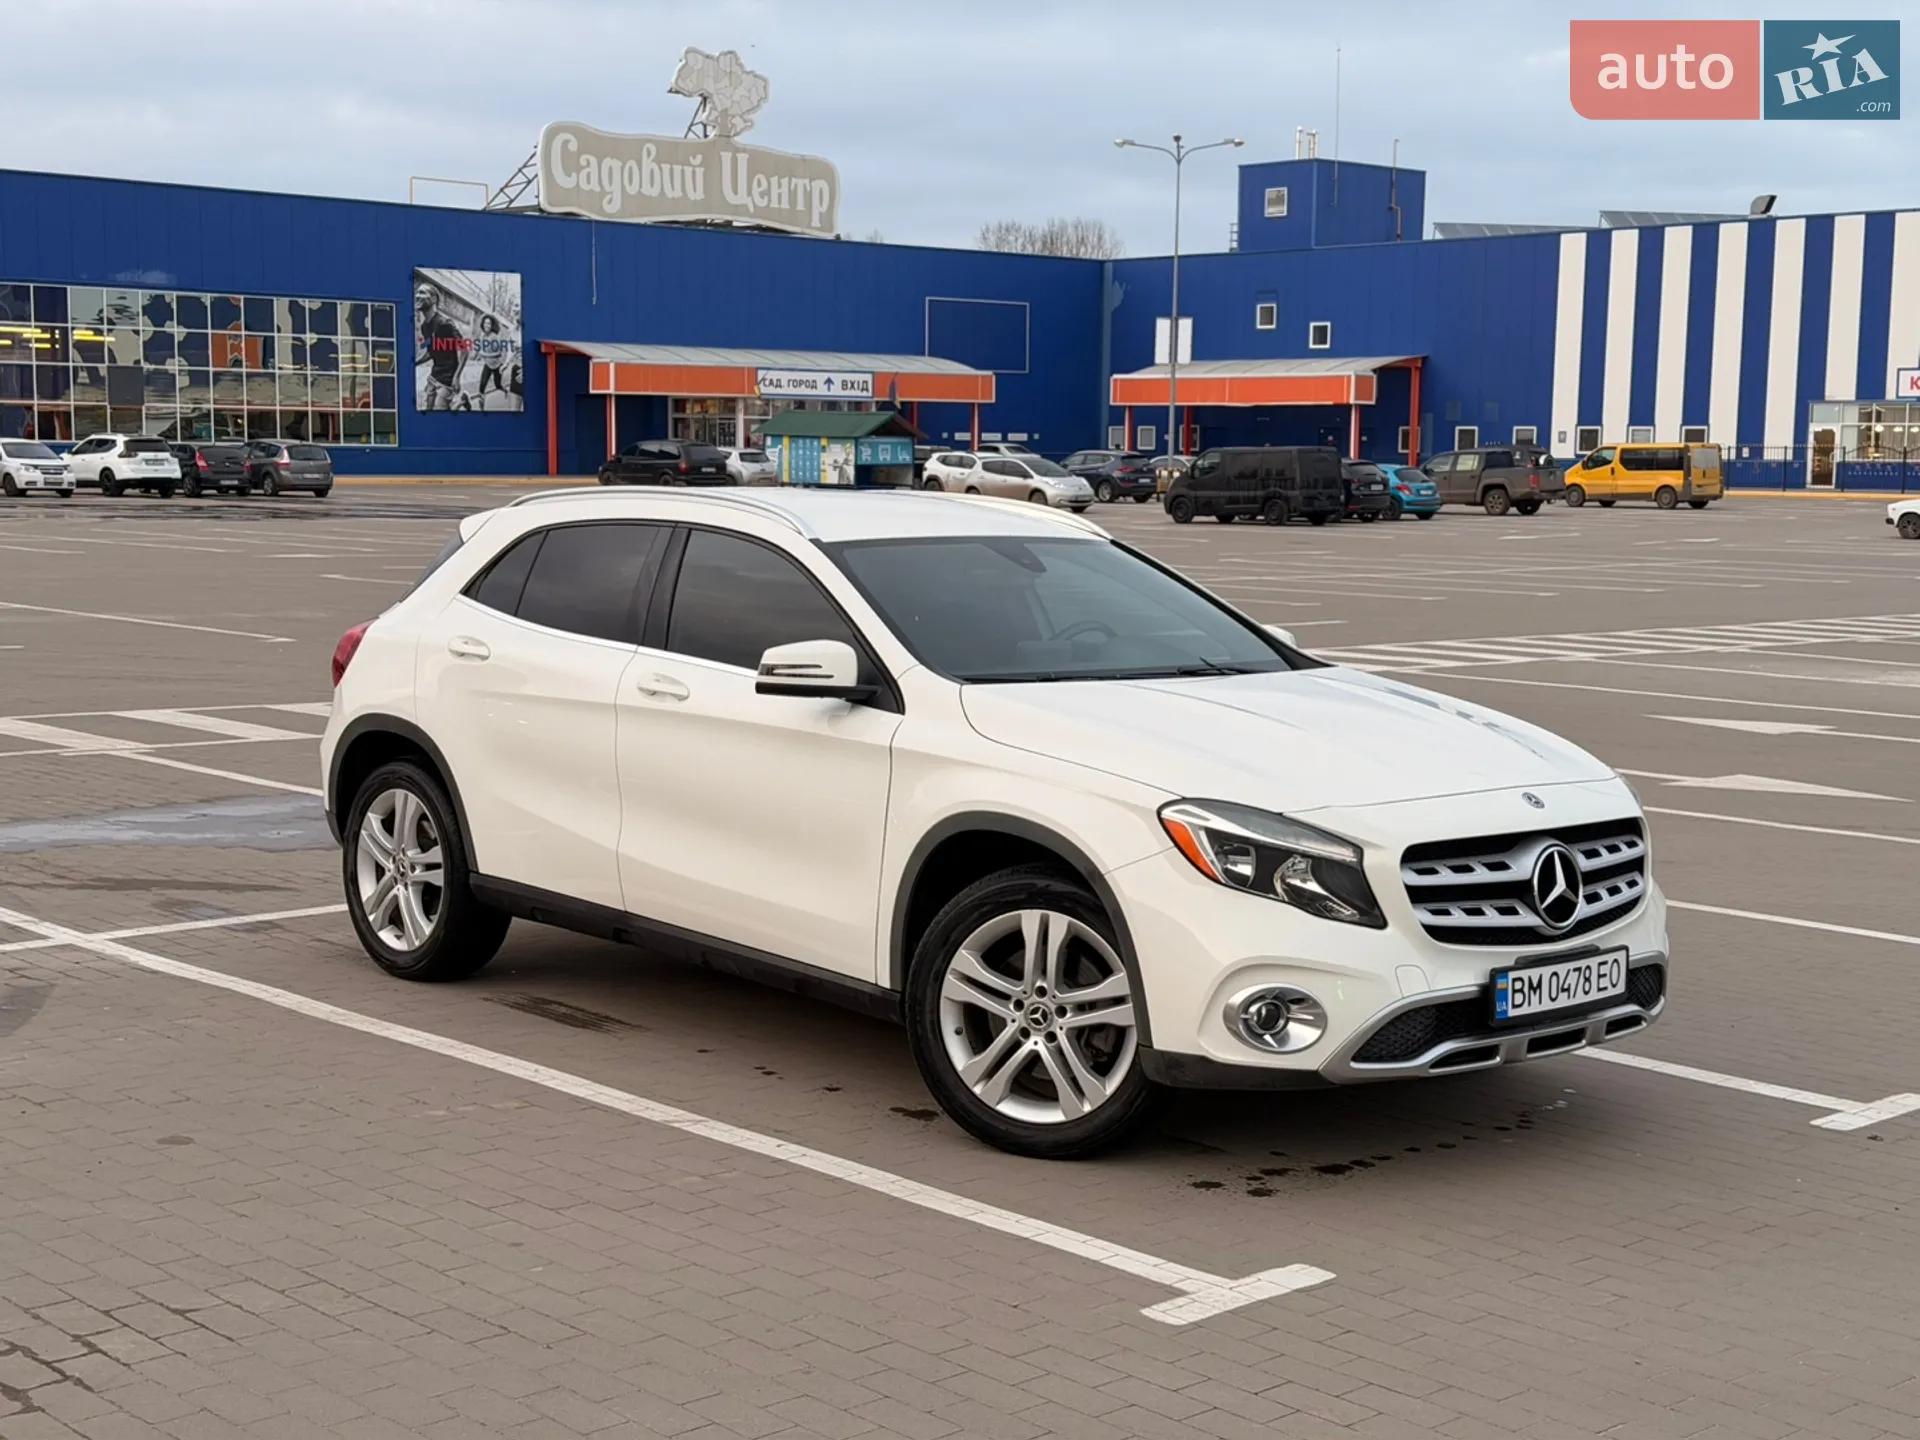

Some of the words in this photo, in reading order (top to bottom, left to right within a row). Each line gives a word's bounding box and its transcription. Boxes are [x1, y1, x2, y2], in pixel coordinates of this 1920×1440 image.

[551, 132, 705, 214] Садовий
[719, 151, 831, 228] Центр
[432, 337, 516, 353] INTERSPORT
[787, 378, 818, 390] ГОРОД
[841, 379, 869, 392] ВХІД
[1511, 973, 1543, 1010] BM
[1549, 965, 1592, 1003] 0478
[1597, 958, 1621, 993] EO
